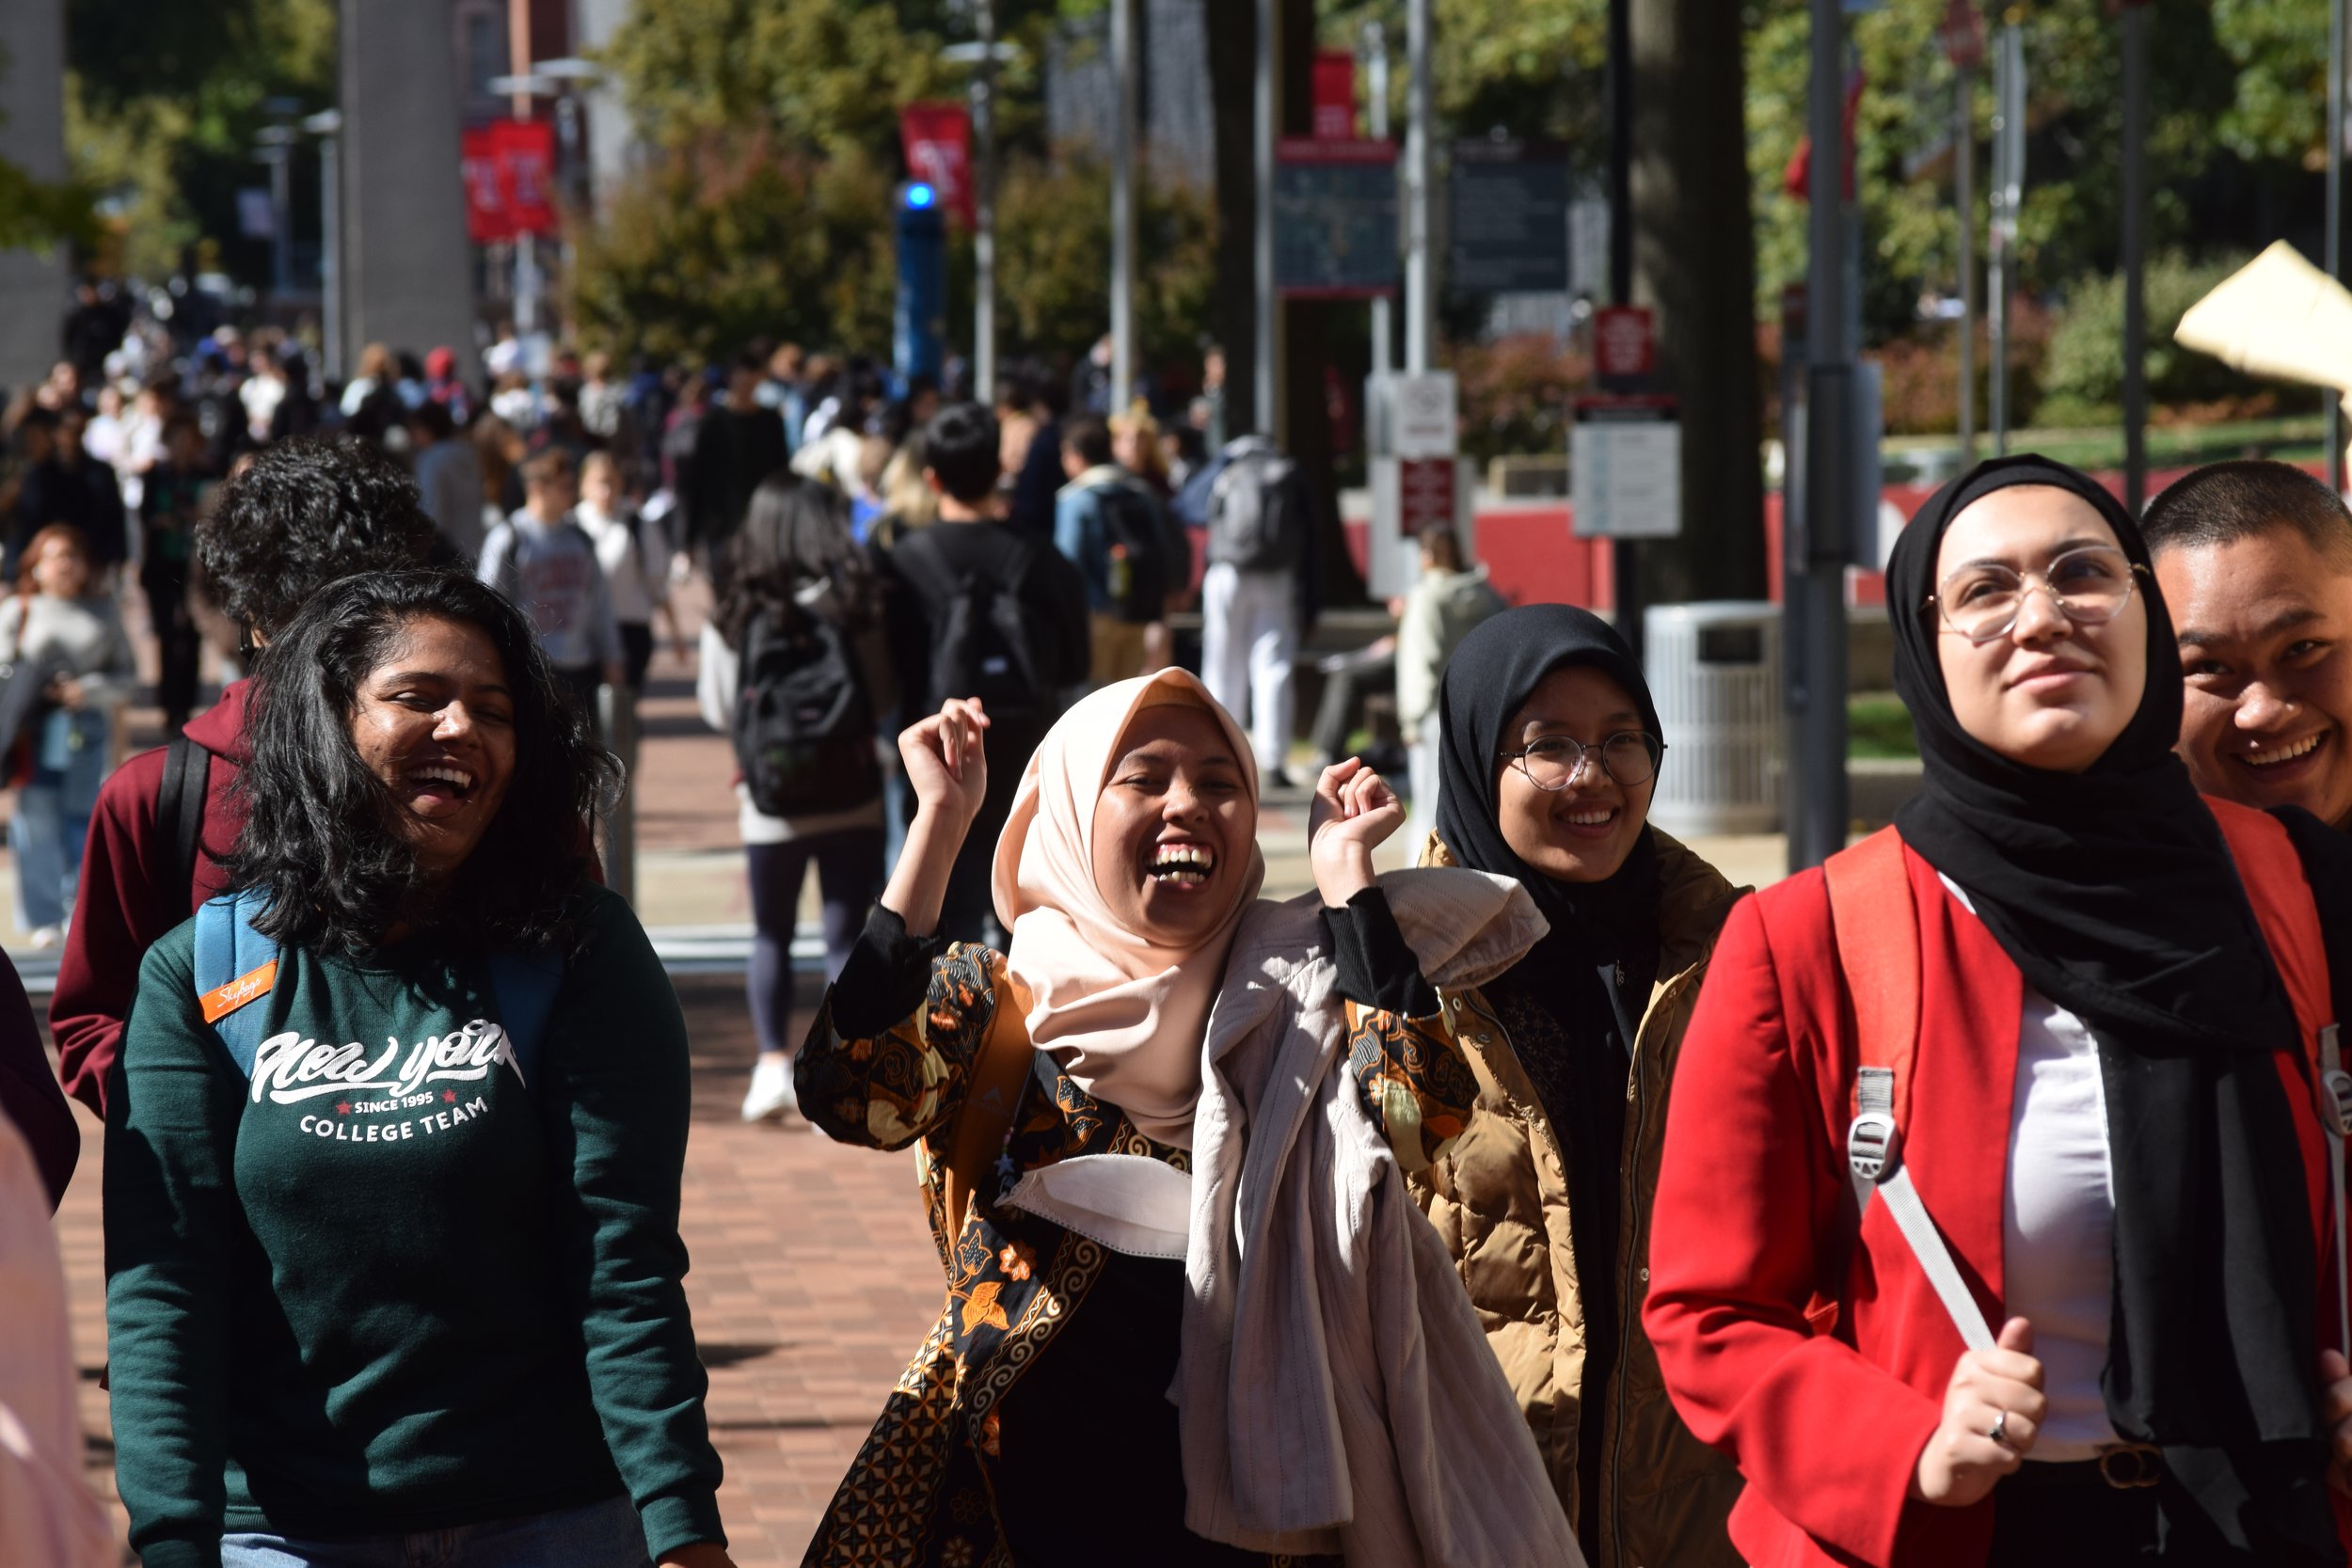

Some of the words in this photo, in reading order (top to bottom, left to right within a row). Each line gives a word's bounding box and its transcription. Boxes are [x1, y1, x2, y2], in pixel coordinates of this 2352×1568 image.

[217, 978, 262, 1008] Skybags
[355, 1100, 399, 1114] SINCE
[401, 1091, 434, 1109] 1995
[300, 1115, 414, 1142] COLLEGE
[420, 1096, 489, 1134] TEAM
